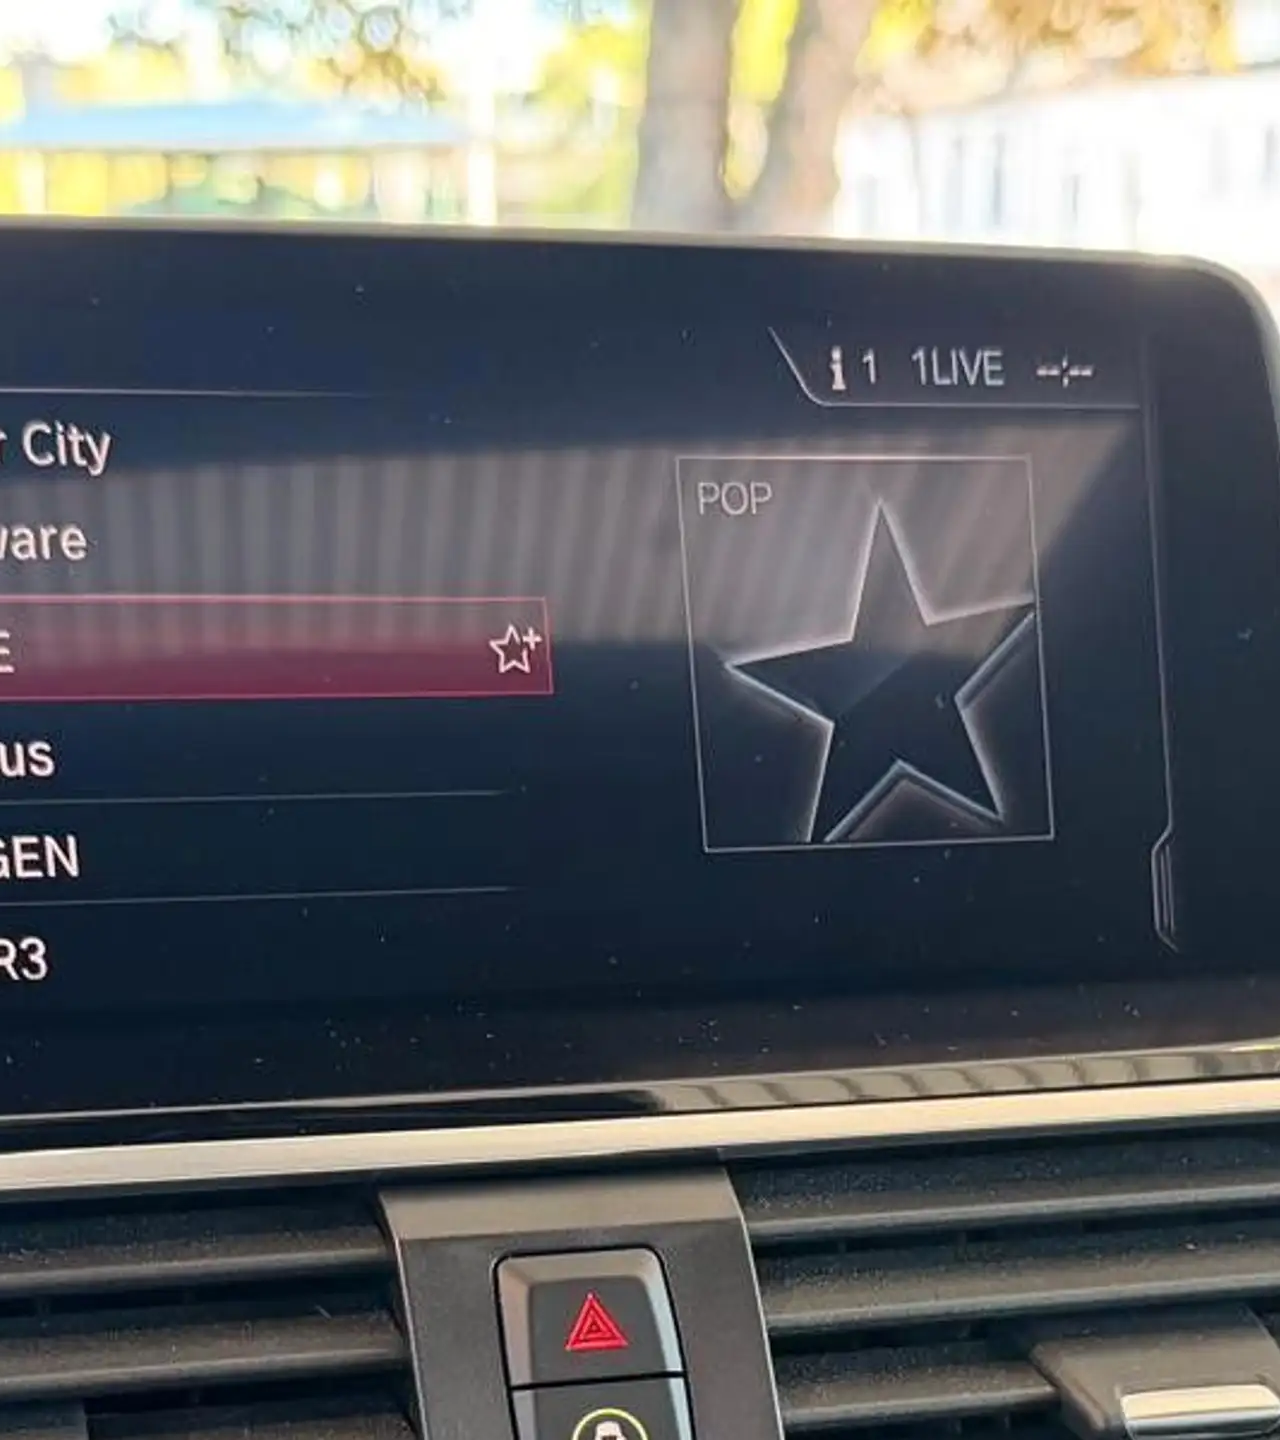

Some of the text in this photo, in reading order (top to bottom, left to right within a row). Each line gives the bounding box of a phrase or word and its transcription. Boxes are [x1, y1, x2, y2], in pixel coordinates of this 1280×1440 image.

[862, 349, 878, 384] 1
[911, 350, 1005, 387] 1LIVE
[23, 424, 111, 476] City
[697, 483, 773, 515] POP
